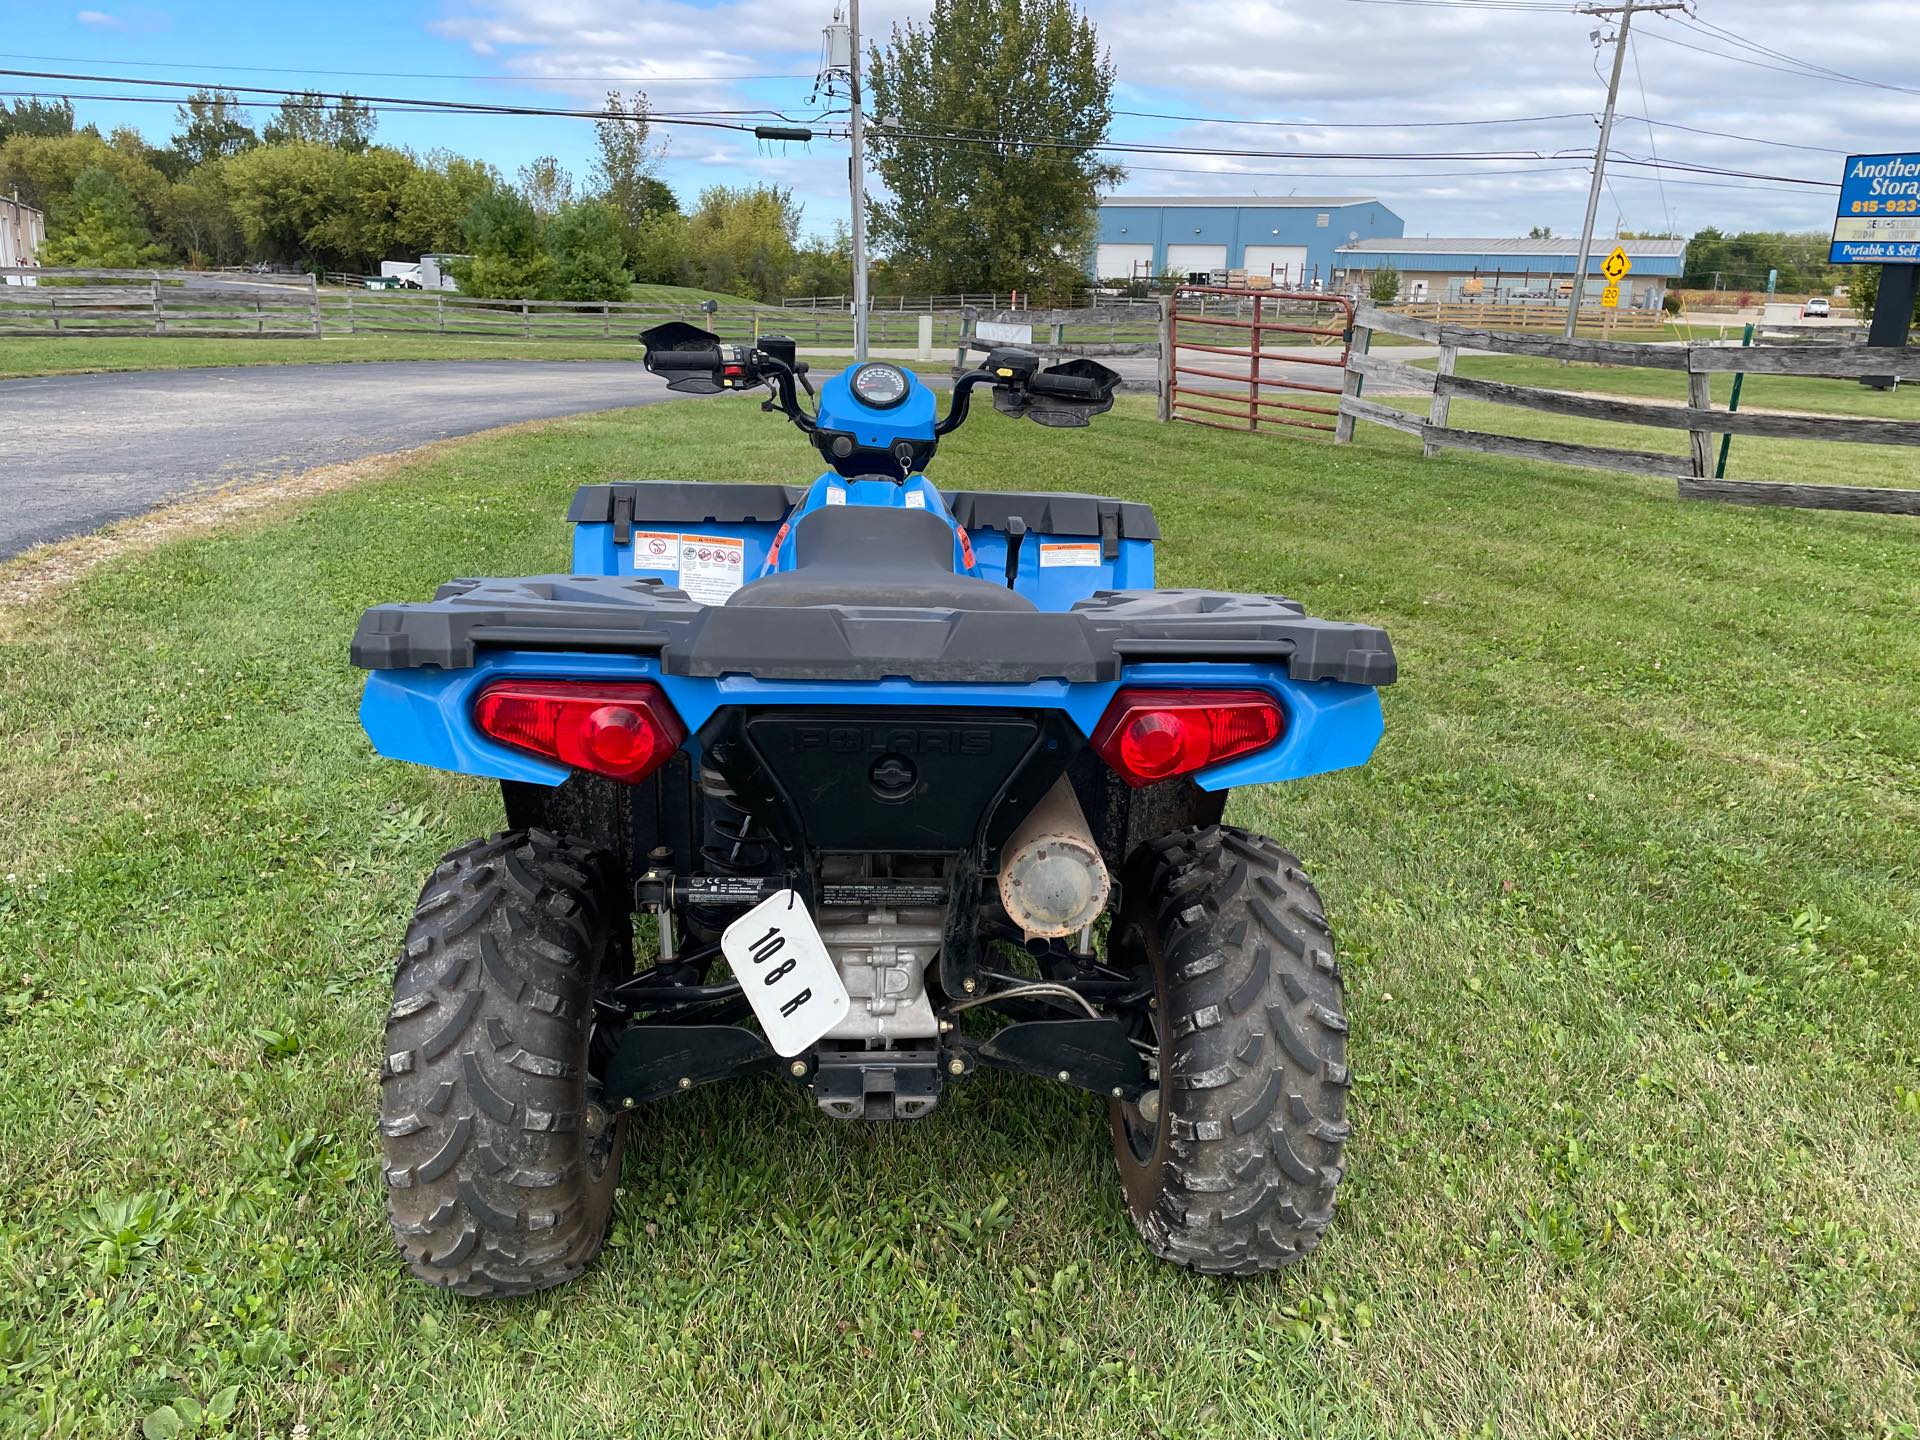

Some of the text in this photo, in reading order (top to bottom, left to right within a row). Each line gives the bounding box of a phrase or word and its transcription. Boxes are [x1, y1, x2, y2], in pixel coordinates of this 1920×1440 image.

[1842, 244, 1918, 256] Portable & Self
[1605, 289, 1618, 299] 20
[793, 727, 992, 754] POLARIS
[779, 987, 812, 1018] R
